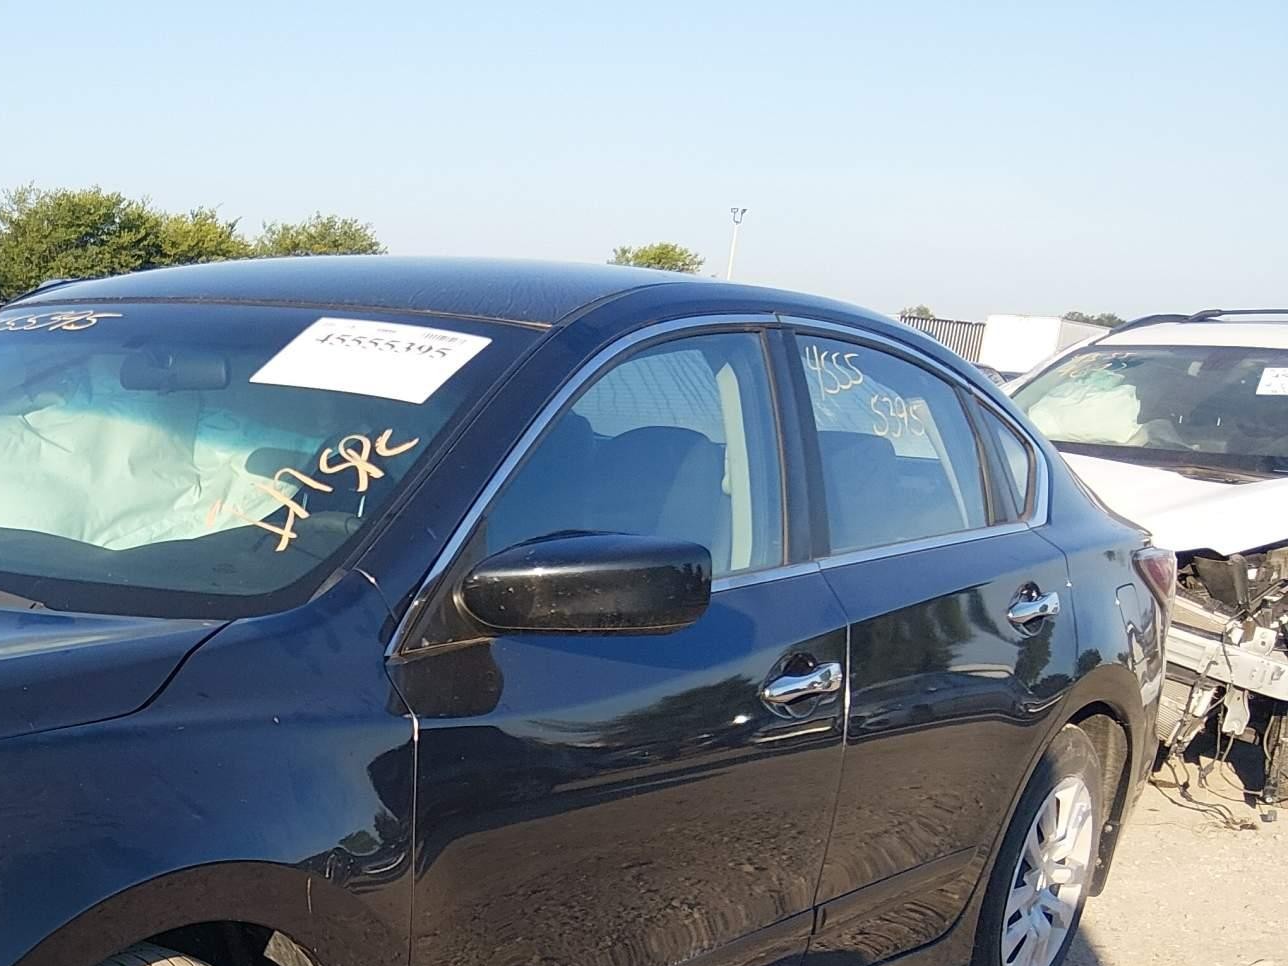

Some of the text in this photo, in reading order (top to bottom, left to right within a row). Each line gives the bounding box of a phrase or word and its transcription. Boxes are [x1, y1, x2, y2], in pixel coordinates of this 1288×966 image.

[315, 333, 453, 359] 45555395
[805, 345, 864, 400] 4555
[870, 393, 926, 437] 5395
